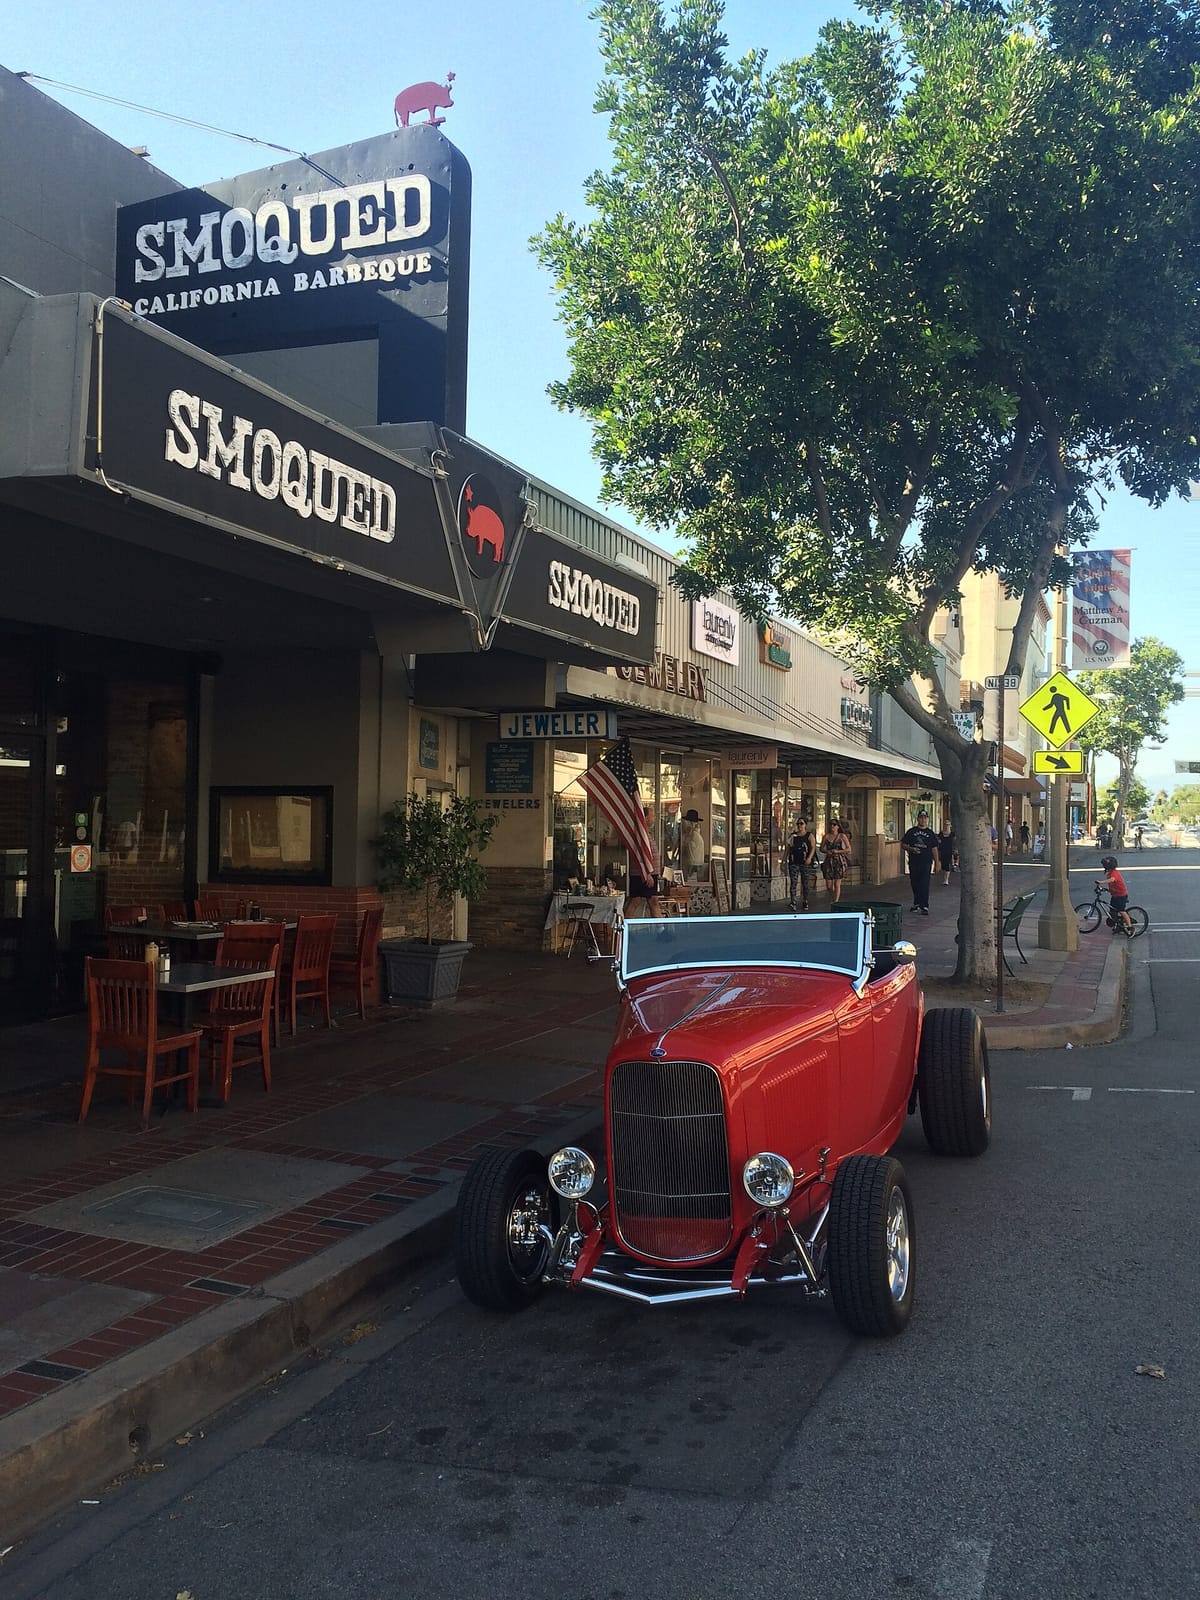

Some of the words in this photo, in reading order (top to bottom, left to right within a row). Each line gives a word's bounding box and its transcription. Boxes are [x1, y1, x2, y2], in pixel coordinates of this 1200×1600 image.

[134, 174, 432, 284] SMOQUED
[134, 277, 281, 317] CALIFORNIA
[293, 252, 432, 292] BARBEQUE
[164, 389, 397, 544] SMOQUED
[548, 559, 640, 636] SMOQUED
[1074, 606, 1114, 616] Matthew
[1116, 605, 1127, 614] A.
[703, 602, 737, 648] laurenly
[1079, 616, 1123, 626] Guzman
[988, 679, 1016, 687] BEIN
[508, 712, 600, 737] JEWELER
[728, 750, 769, 761] laurenly
